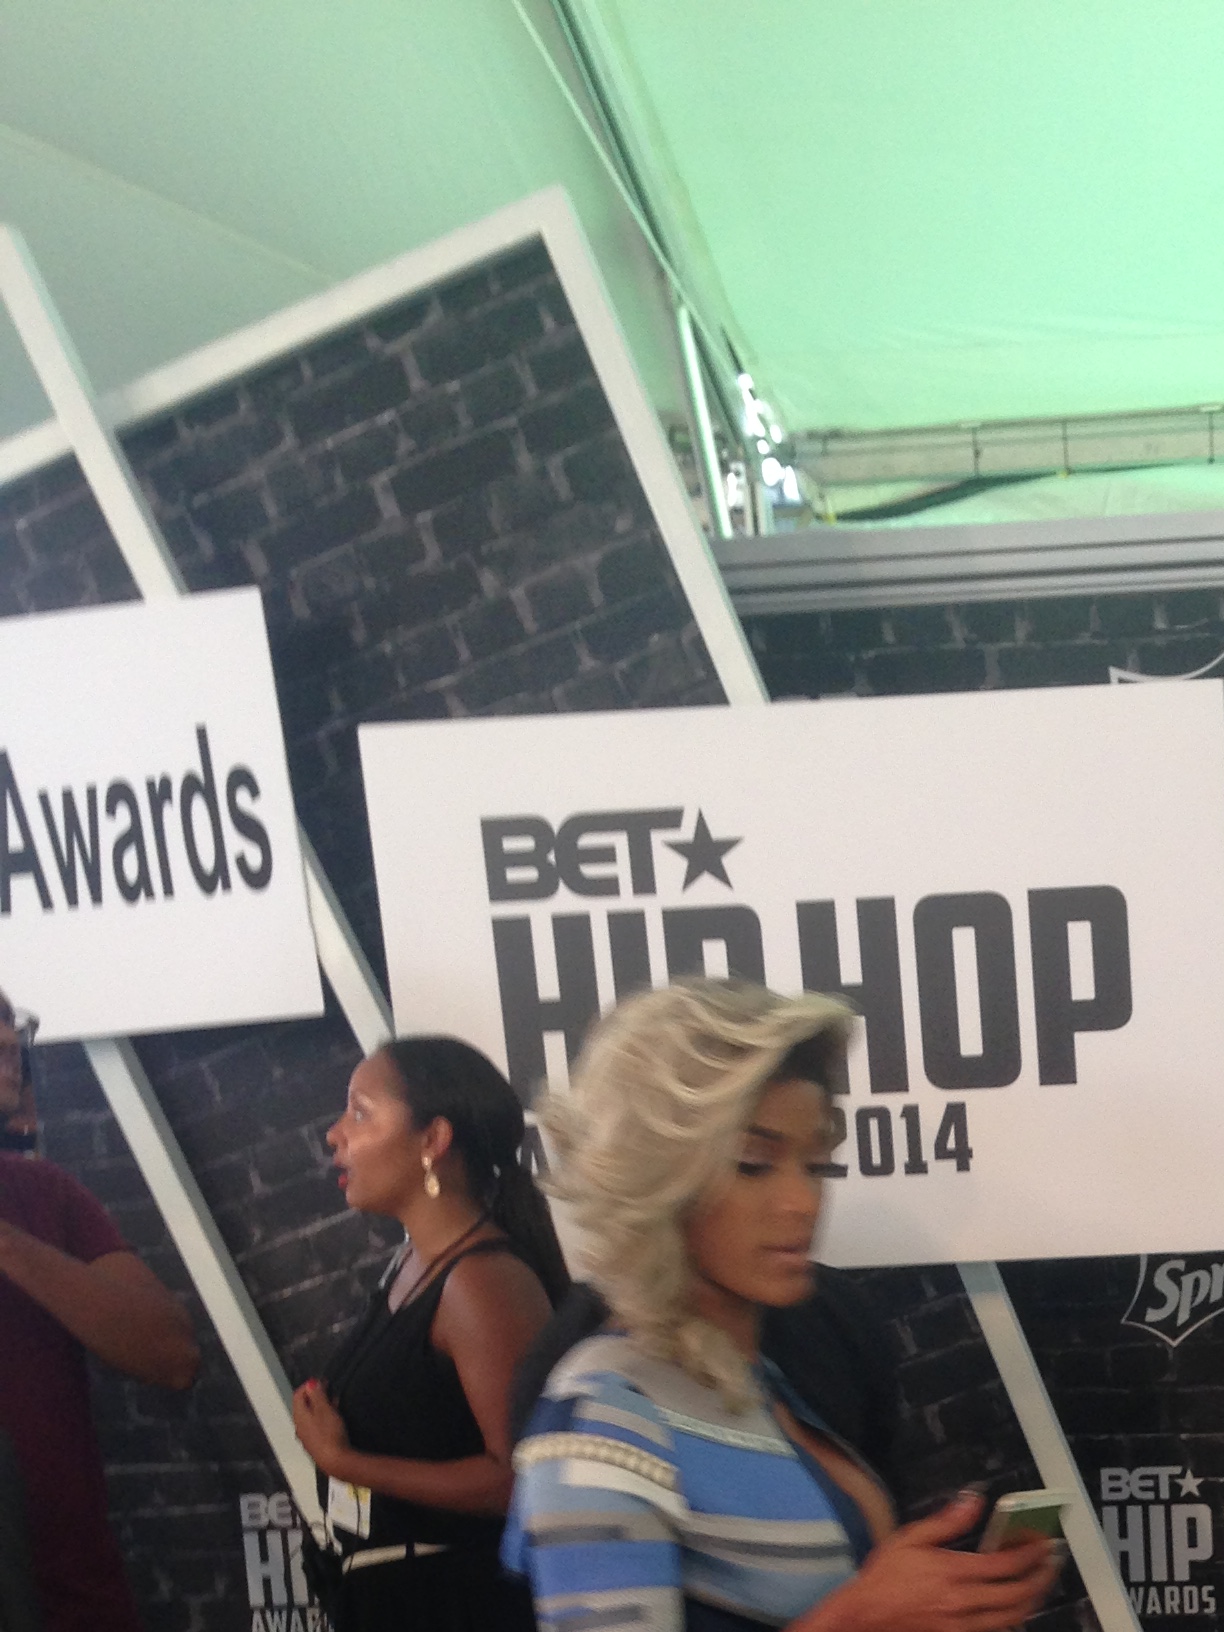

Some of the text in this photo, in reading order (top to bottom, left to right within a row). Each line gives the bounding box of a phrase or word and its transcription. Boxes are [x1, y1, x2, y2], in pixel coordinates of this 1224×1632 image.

[0, 722, 273, 918] Awards
[480, 805, 685, 902] BET
[795, 883, 1134, 1096] HOP
[239, 1491, 301, 1530] BE
[1099, 1465, 1184, 1501] BET
[243, 1528, 320, 1609] HI
[1101, 1503, 1215, 1583] HIP
[1130, 1584, 1217, 1615] ARDS
